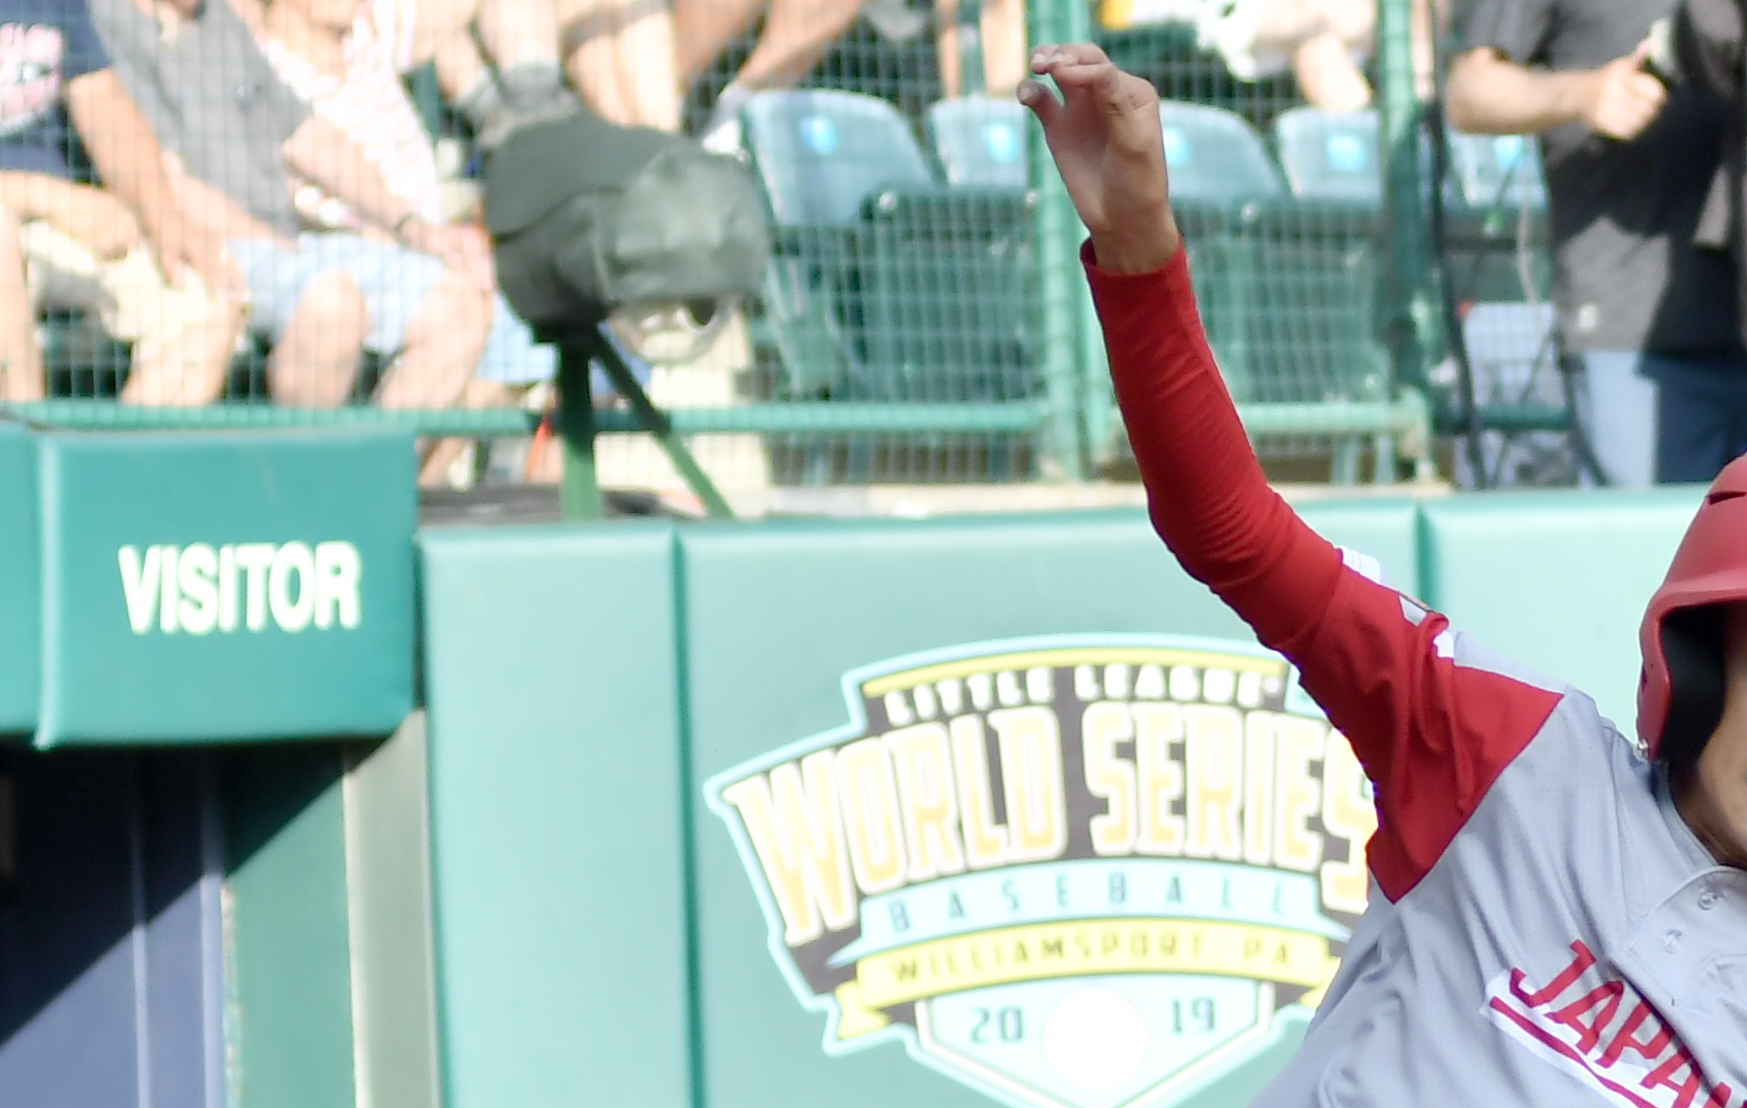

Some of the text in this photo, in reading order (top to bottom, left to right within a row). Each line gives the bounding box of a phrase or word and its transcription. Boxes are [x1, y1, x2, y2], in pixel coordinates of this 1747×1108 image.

[118, 541, 362, 635] VISITOR
[885, 665, 1054, 727] LITTLE
[722, 701, 1380, 947] WORLD SERIES
[888, 871, 1285, 934] BASEBALL
[1243, 936, 1290, 966] PA
[969, 997, 1216, 1044] 20 19
